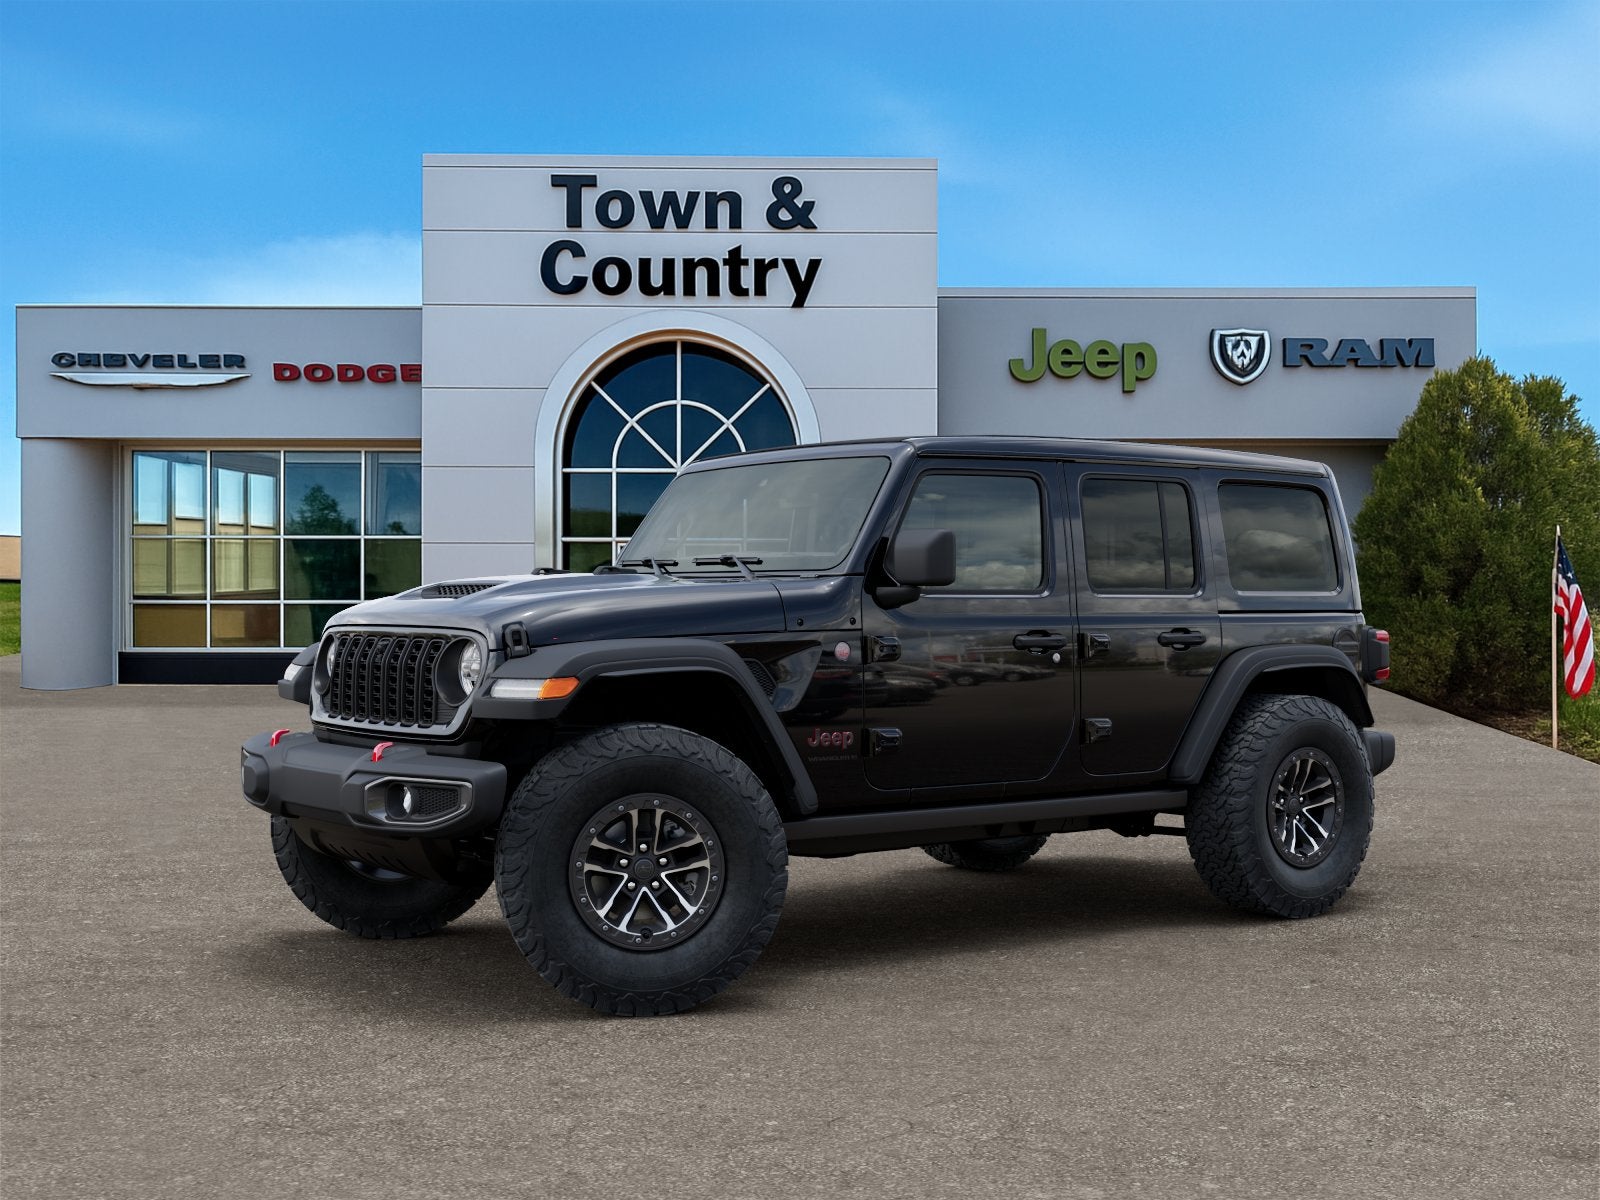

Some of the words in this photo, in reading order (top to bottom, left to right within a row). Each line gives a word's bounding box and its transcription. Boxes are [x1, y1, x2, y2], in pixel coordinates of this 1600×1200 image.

[550, 174, 743, 230] Town
[765, 175, 818, 230] &
[540, 239, 823, 308] Country
[273, 362, 422, 384] DODGE
[1009, 327, 1158, 393] Jeep
[1282, 337, 1436, 368] RAM
[807, 728, 854, 751] Jeep
